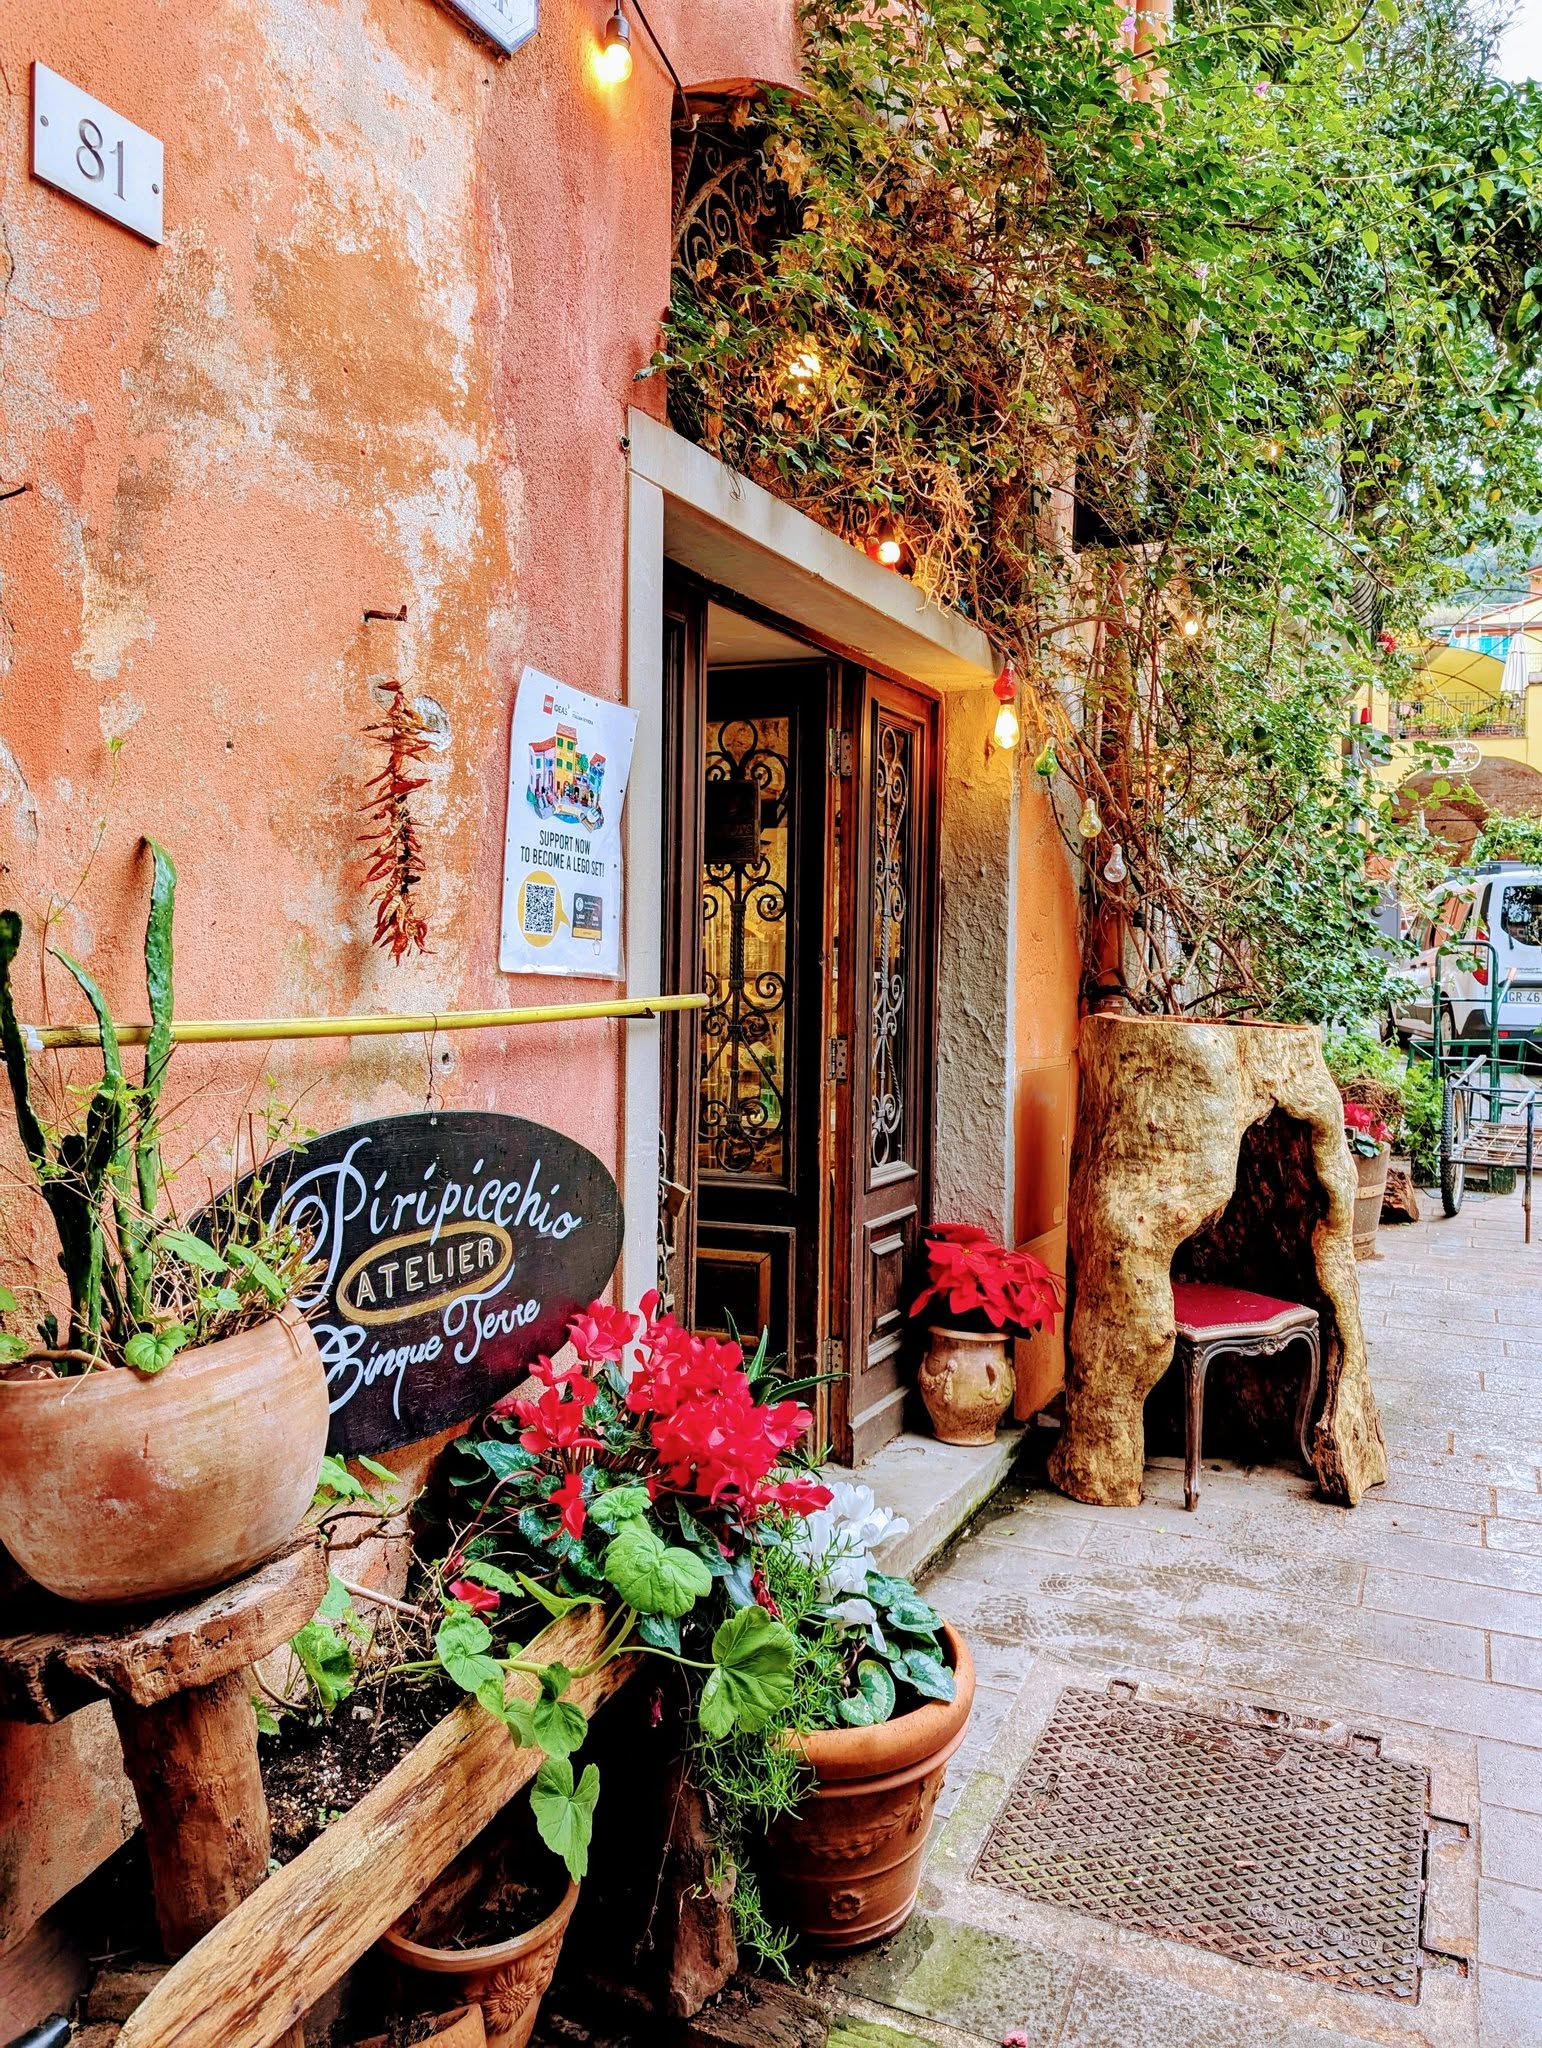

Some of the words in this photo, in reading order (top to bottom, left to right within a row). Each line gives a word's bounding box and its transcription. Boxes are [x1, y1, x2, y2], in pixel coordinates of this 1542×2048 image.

[76, 118, 126, 201] 81
[520, 845, 531, 863] TO
[532, 848, 565, 870] BECOME
[566, 855, 572, 871] A
[573, 856, 590, 875] LEGO
[591, 860, 605, 878] SET!
[539, 829, 574, 852] SUPPORT
[574, 838, 591, 856] NOW
[1508, 991, 1523, 1002] GR
[270, 1137, 582, 1308] Piripicchio
[356, 1237, 494, 1307] ATELIER
[443, 1264, 541, 1364] Terre
